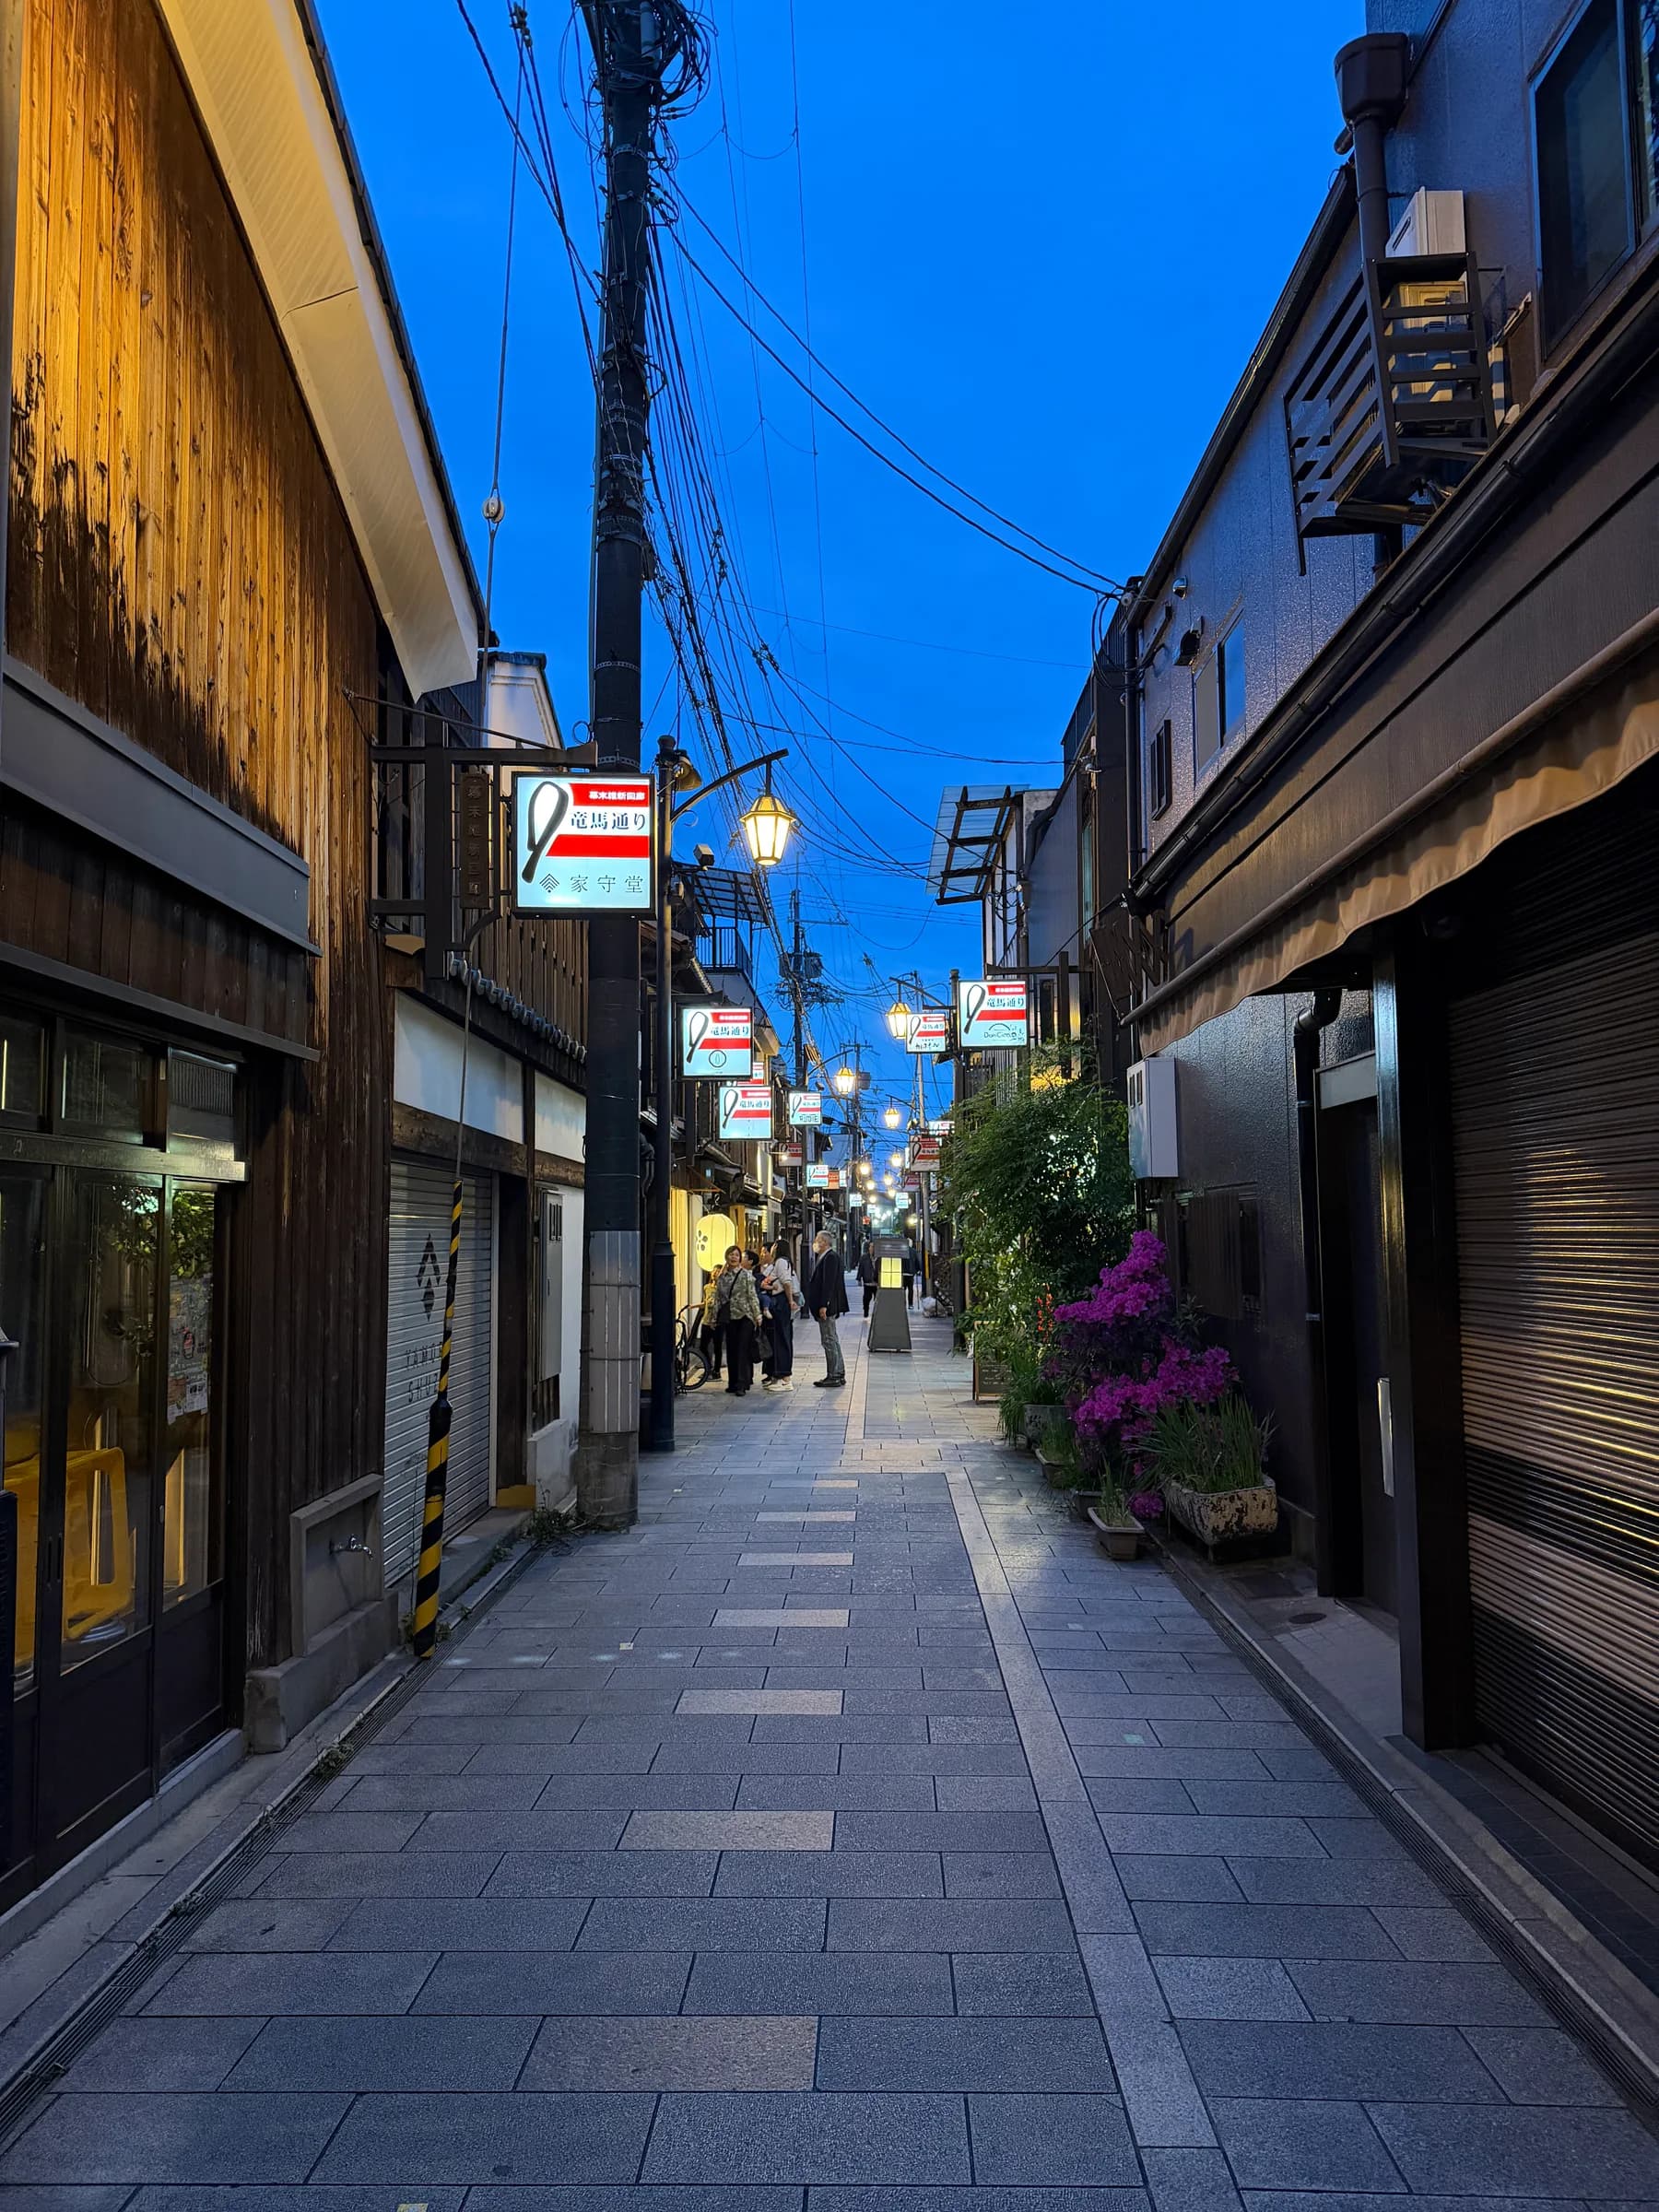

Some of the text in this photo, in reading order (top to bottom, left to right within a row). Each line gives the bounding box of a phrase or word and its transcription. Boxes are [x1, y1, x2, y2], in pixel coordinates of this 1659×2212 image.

[571, 811, 646, 830] 竜馬通り
[570, 875, 644, 894] 家守堂
